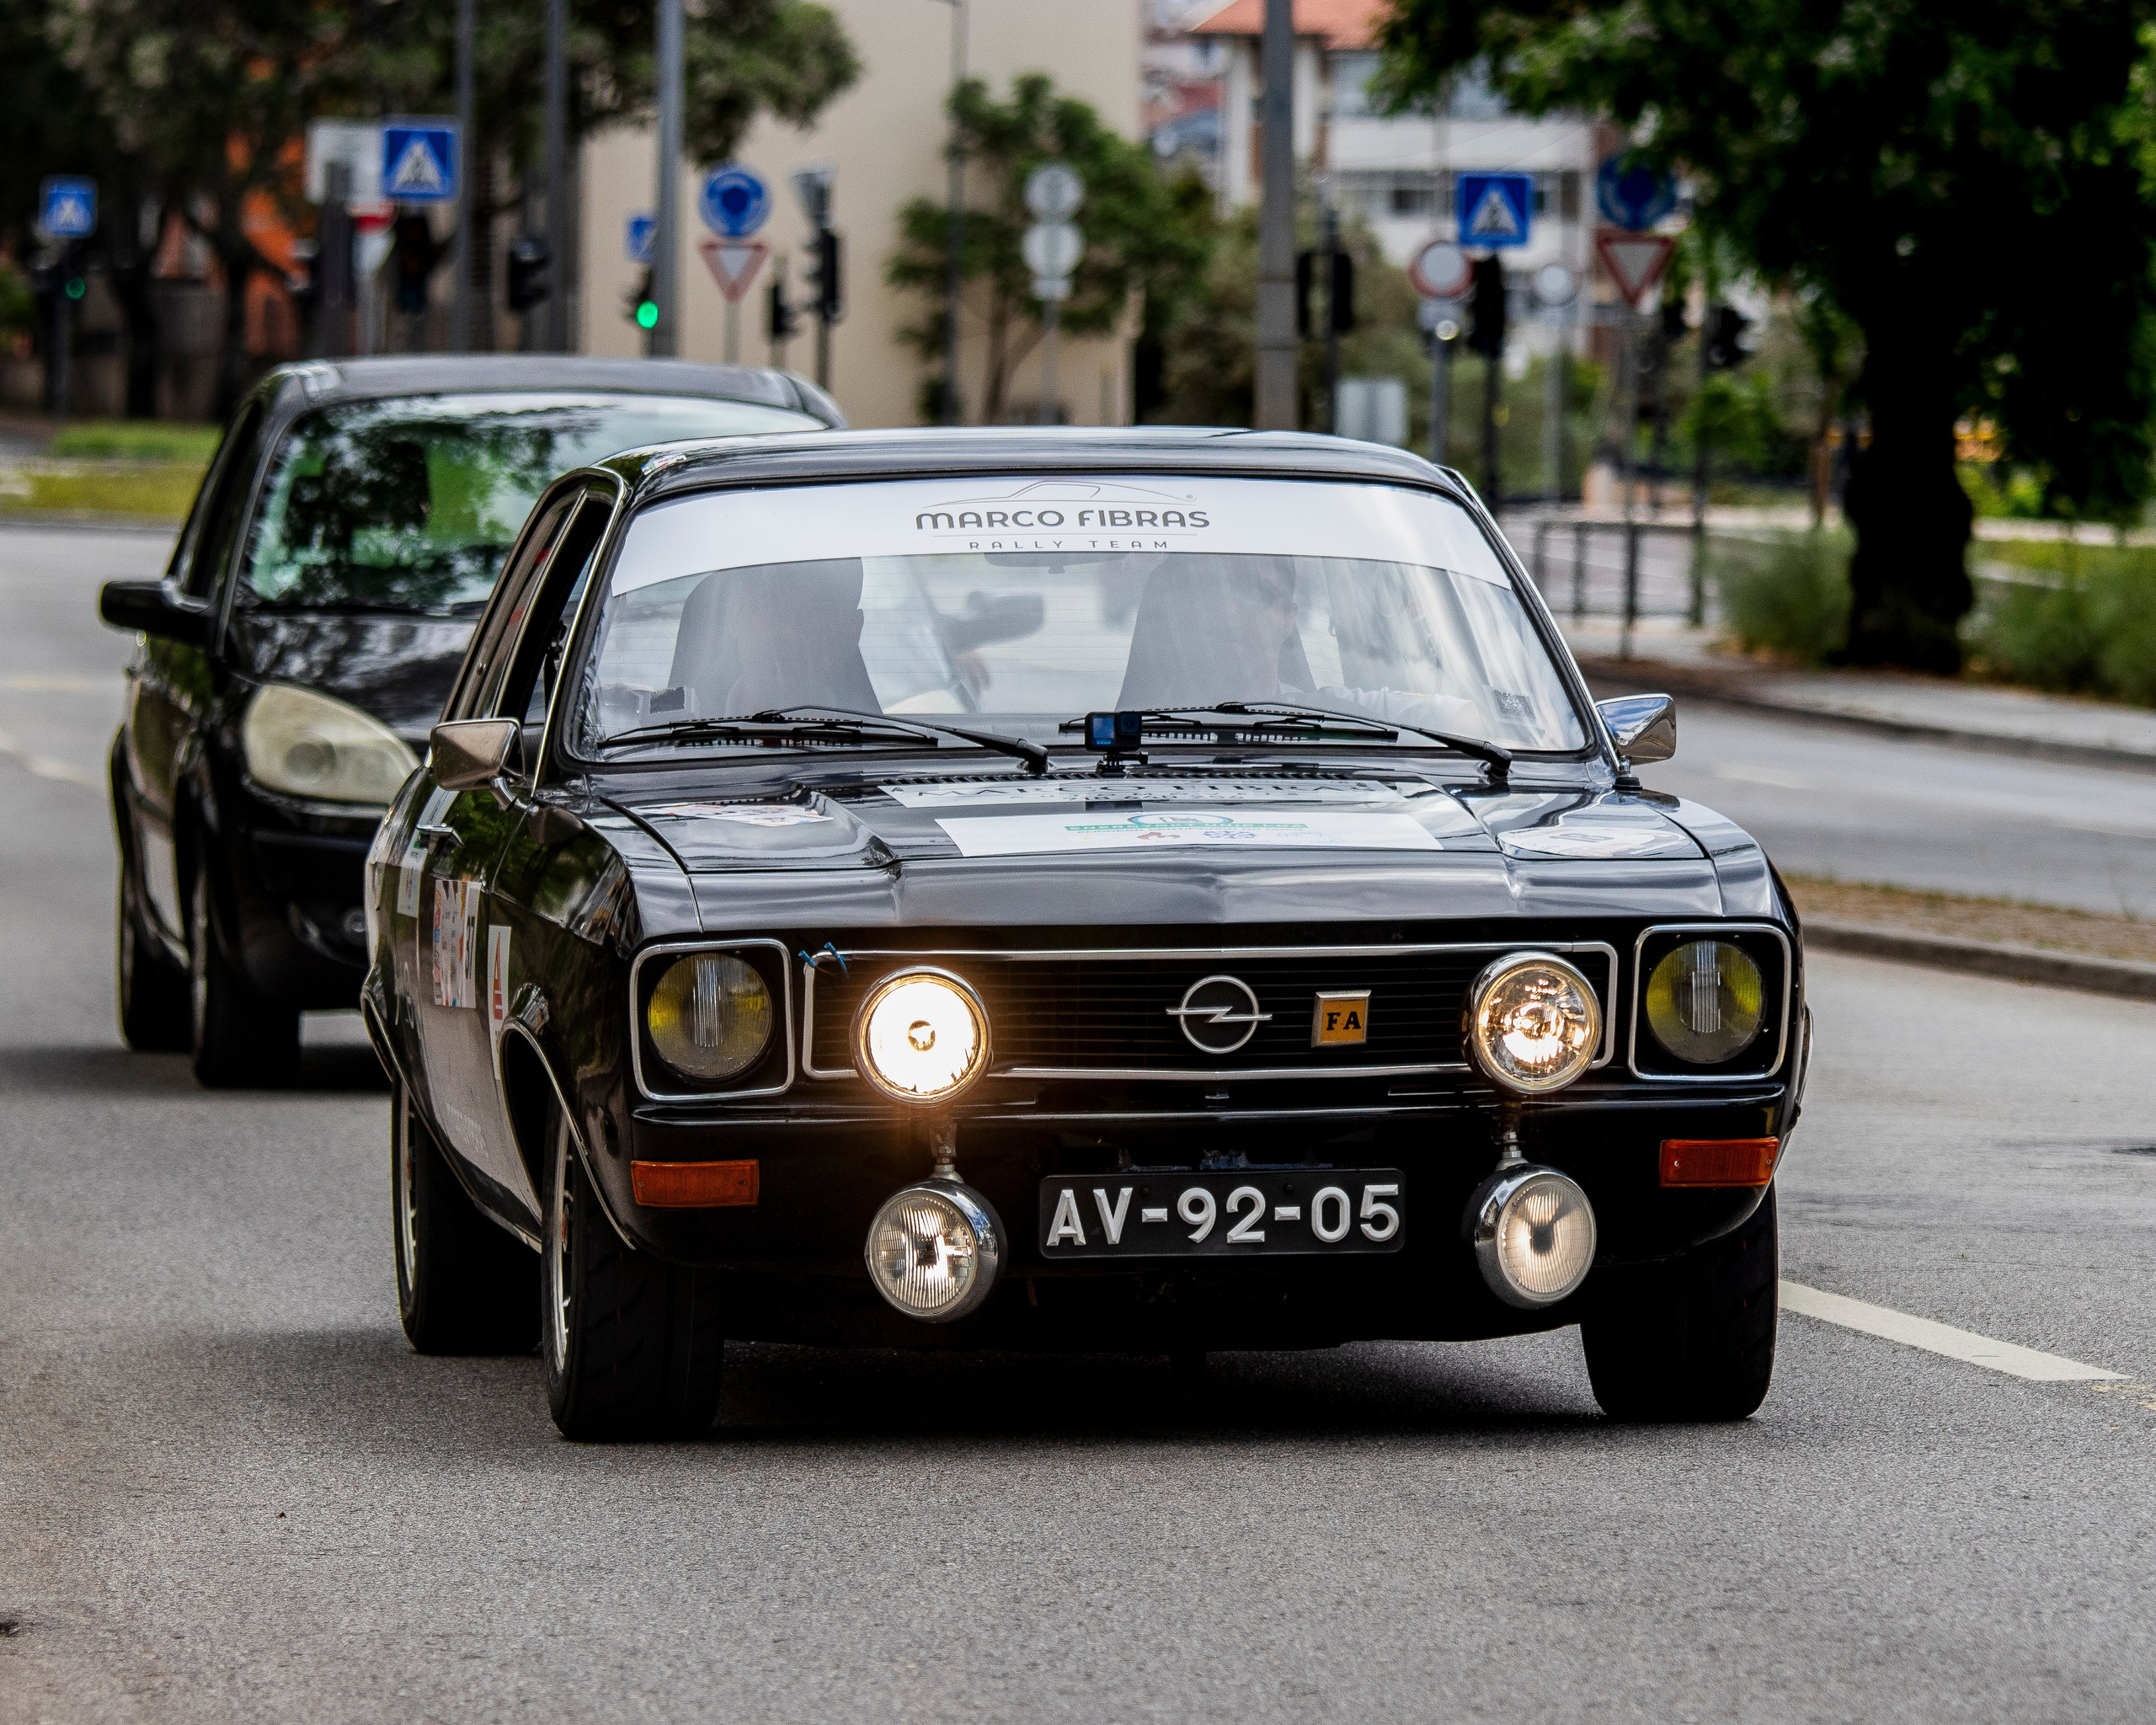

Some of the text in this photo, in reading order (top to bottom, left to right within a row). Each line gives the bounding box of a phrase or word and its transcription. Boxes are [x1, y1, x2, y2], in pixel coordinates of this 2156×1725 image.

[915, 510, 1210, 530] MARCO FIBRAS
[969, 540, 1168, 549] RALLY TEAM
[1326, 1011, 1362, 1031] FA
[1046, 1183, 1400, 1247] AV-92-05
